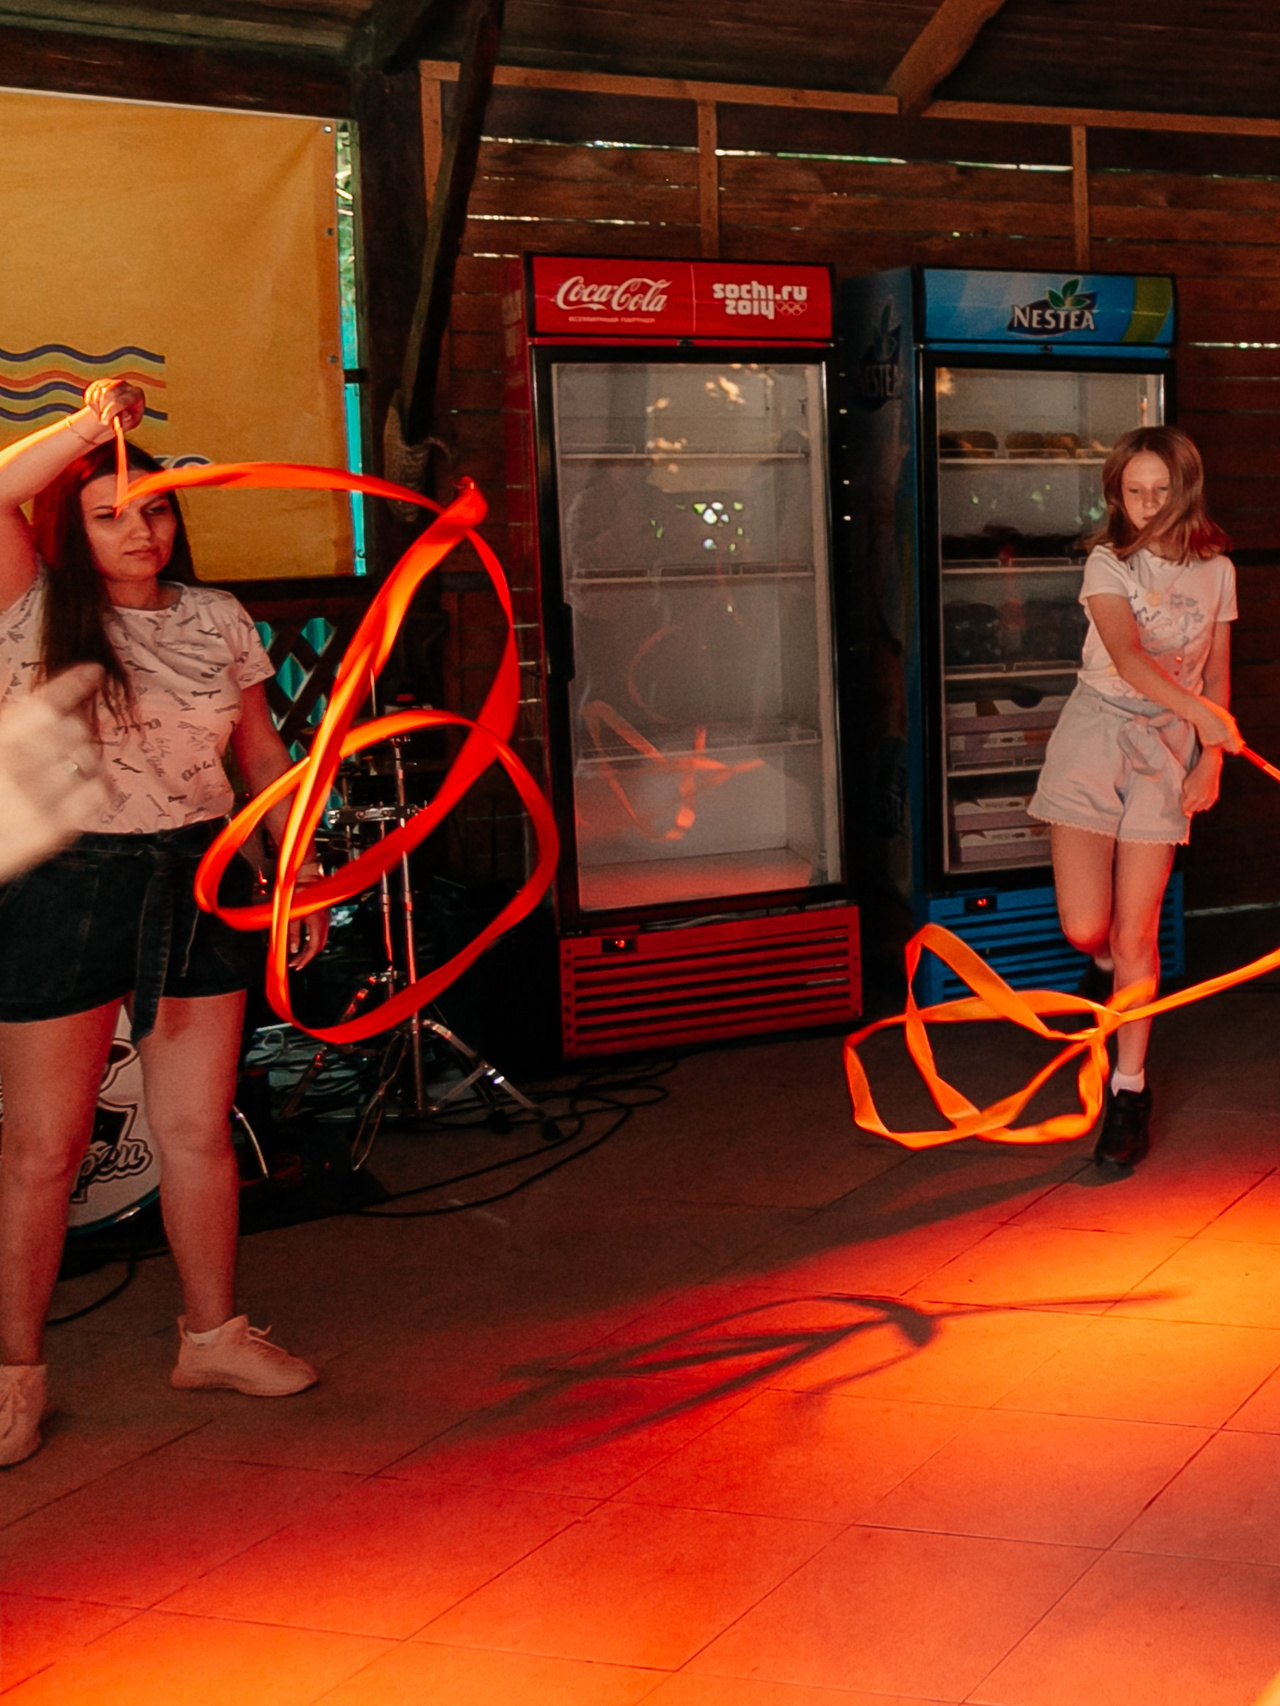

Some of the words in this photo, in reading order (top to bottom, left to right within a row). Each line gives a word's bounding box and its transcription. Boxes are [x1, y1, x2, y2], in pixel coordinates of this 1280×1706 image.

[556, 275, 673, 312] Coca-Cola
[712, 280, 808, 301] sochi.ru
[724, 299, 775, 320] 2014
[1012, 304, 1096, 330] NESTEA
